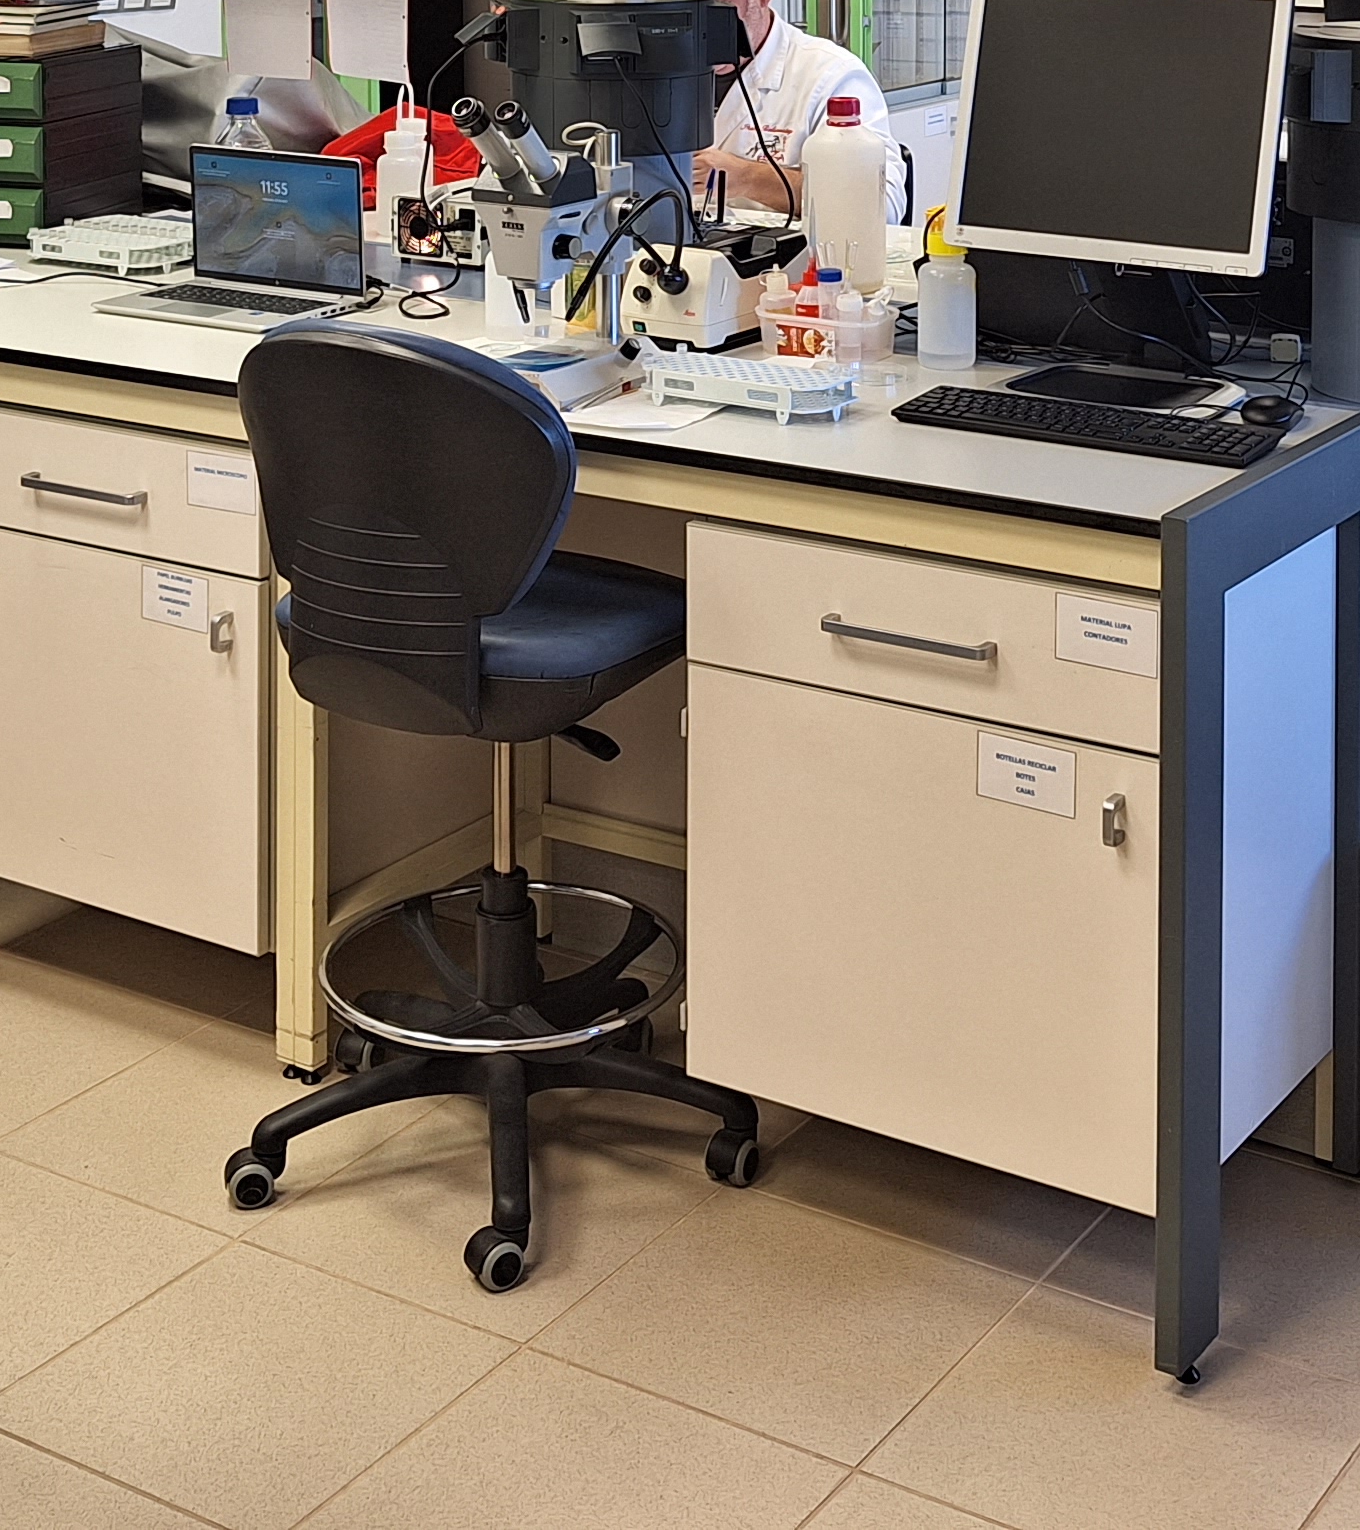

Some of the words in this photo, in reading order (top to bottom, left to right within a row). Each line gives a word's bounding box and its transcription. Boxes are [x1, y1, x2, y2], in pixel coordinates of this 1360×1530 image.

[260, 180, 289, 196] 11:55
[1080, 615, 1114, 628] MATERIAL
[1114, 621, 1132, 631] LUPA
[1083, 630, 1128, 645] CONTADORES
[995, 752, 1026, 765] BOTELLAS
[1027, 759, 1057, 772] RECICLAR
[1015, 771, 1036, 782] BOTES
[1015, 786, 1036, 796] CAJAS
